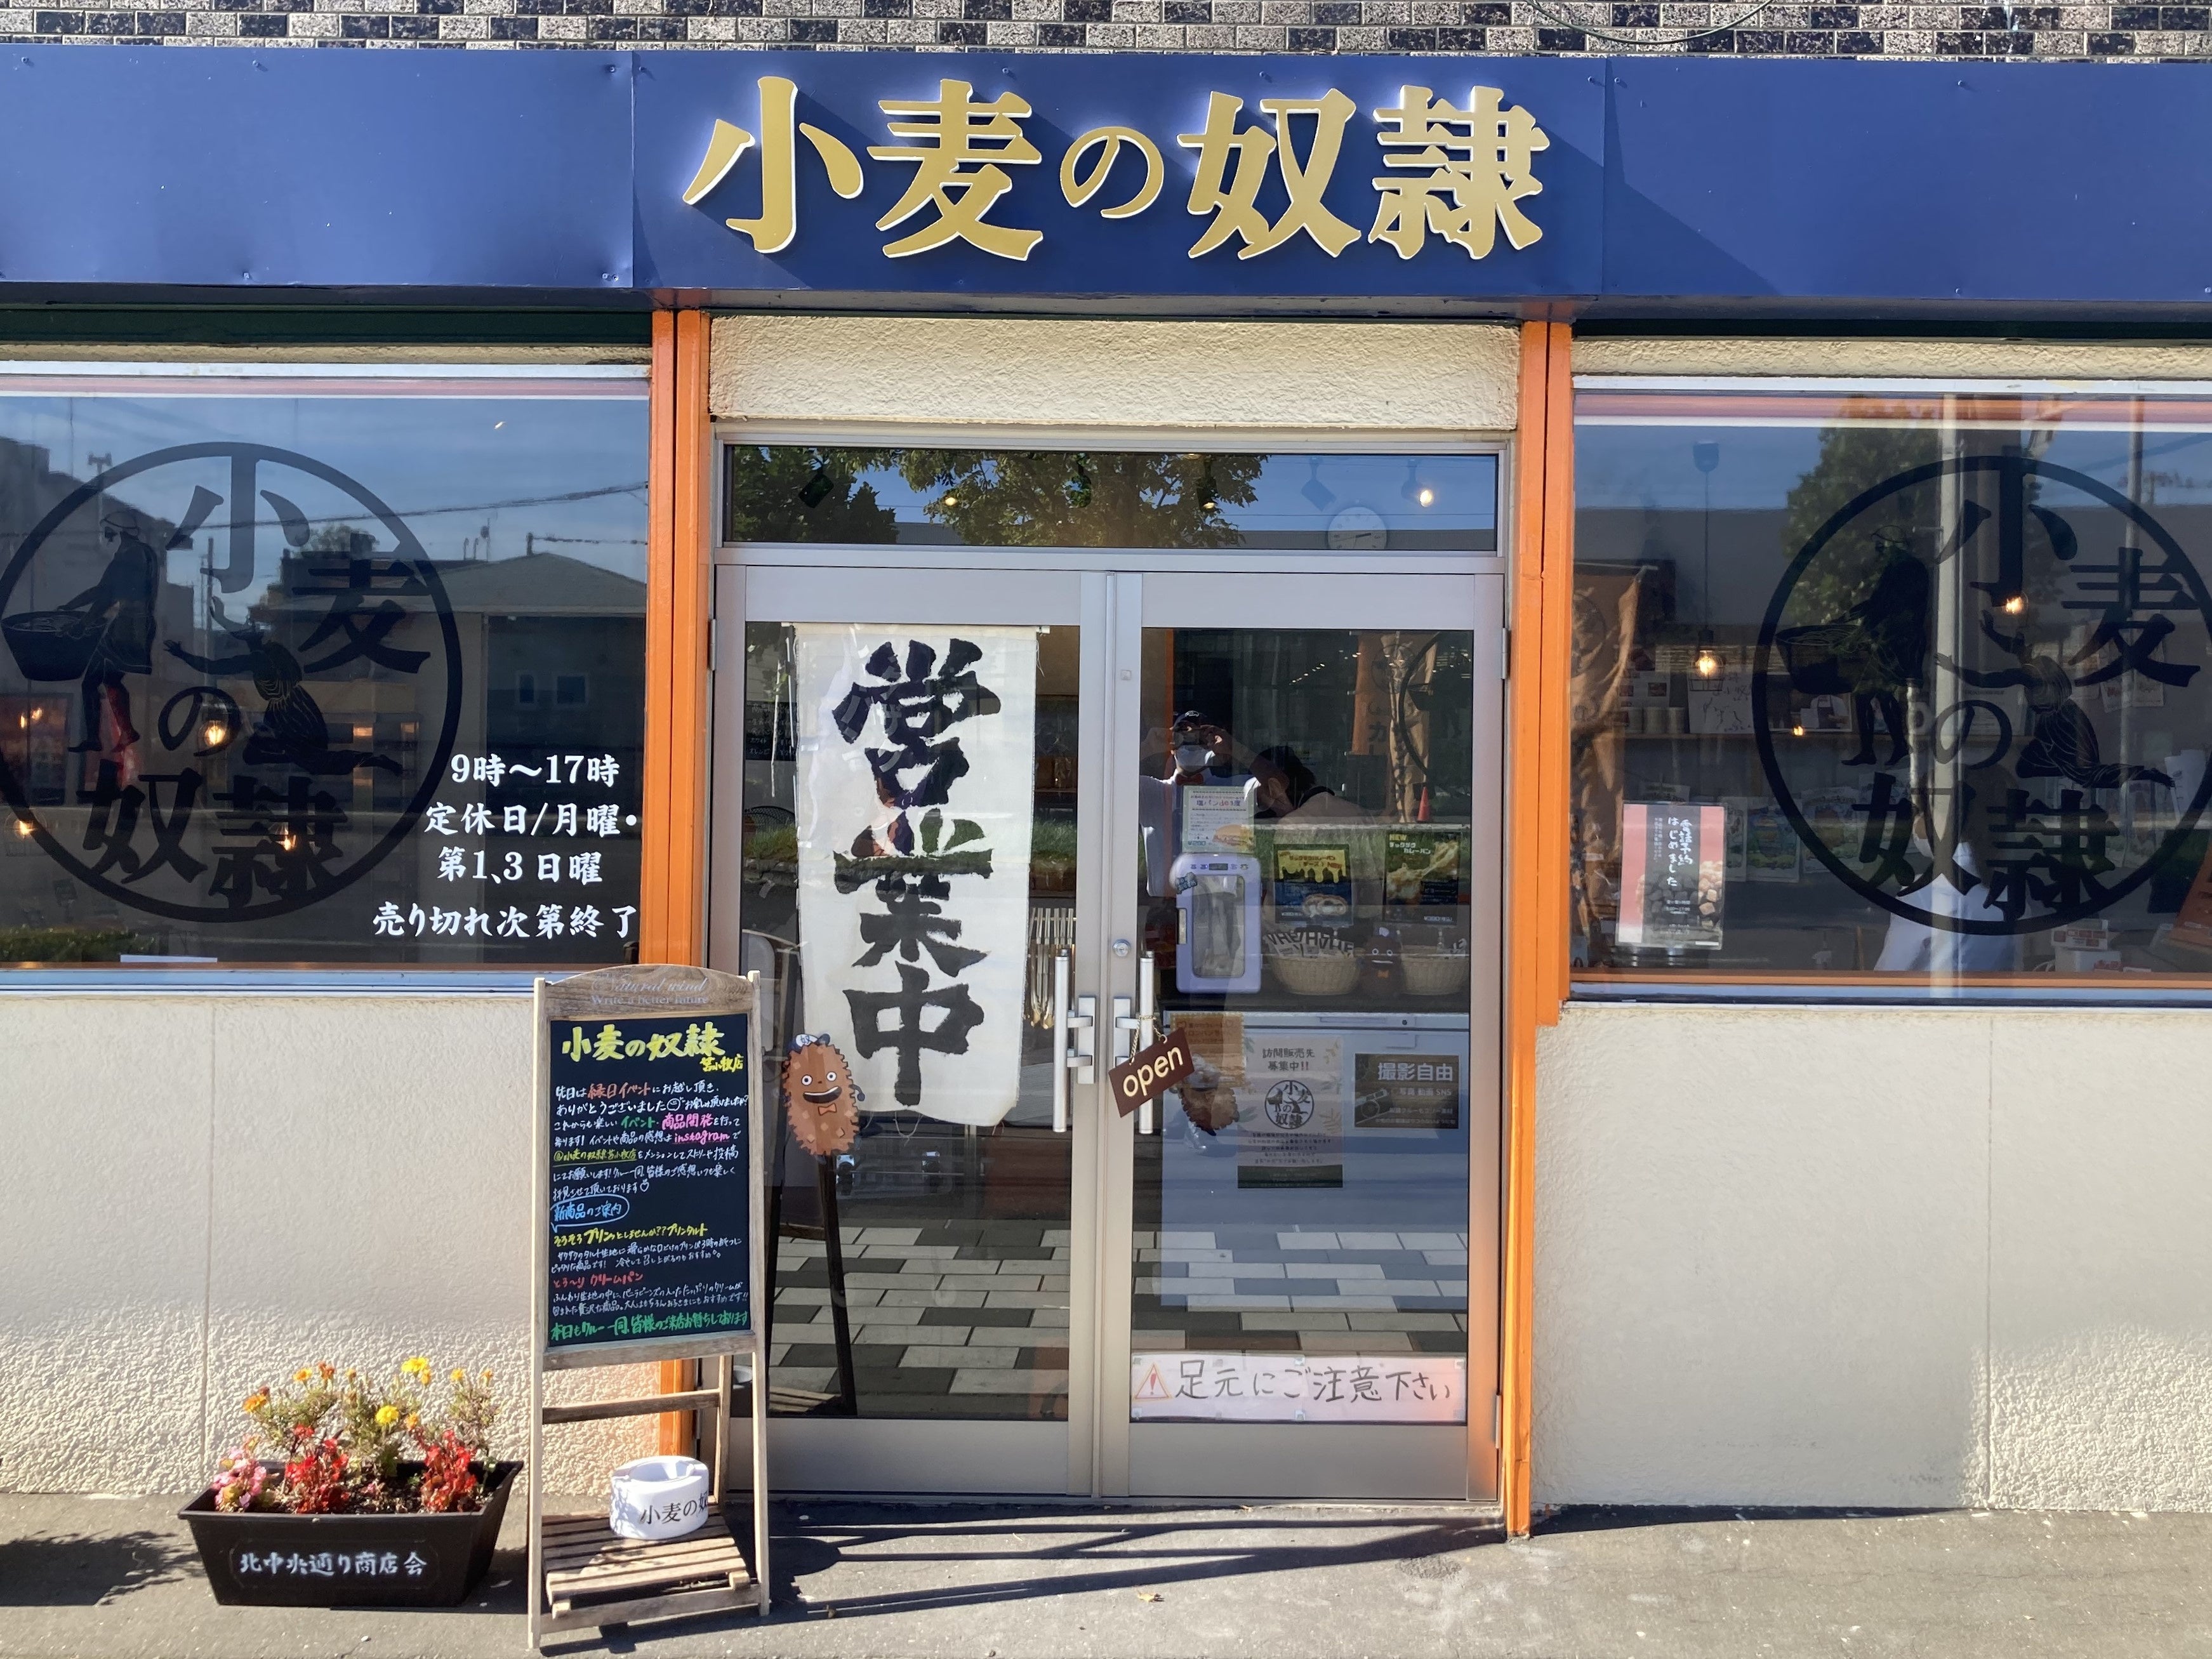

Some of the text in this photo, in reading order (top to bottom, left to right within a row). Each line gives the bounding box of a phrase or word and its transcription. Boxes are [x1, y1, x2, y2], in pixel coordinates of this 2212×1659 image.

[682, 76, 1549, 261] 小麦の奴隷
[451, 753, 620, 787] 9時〜17時
[832, 638, 1001, 1106] 営業中
[1666, 817, 1679, 887] はじめました
[373, 901, 637, 940] 売り切れ次第終了
[562, 1021, 725, 1062] 小麦の奴隷
[1262, 1047, 1315, 1059] 訪問販売先
[1123, 1047, 1184, 1097] open
[1377, 1062, 1454, 1081] 撮影自由
[1436, 1088, 1452, 1097] SNS
[1175, 1359, 1452, 1402] 足元にご注意下さい
